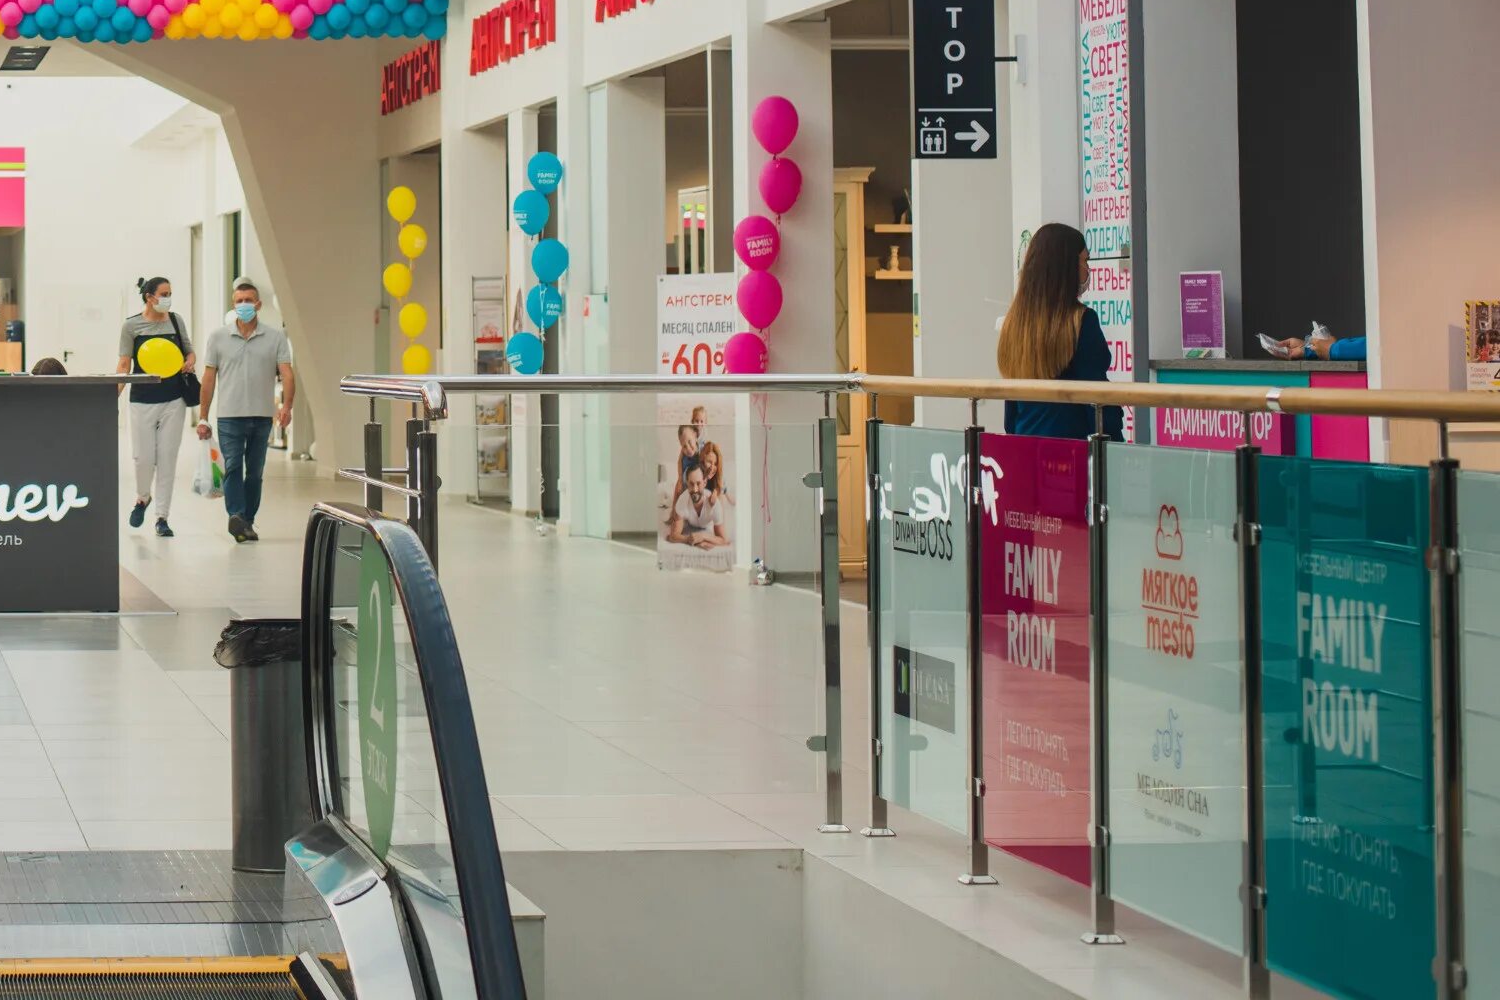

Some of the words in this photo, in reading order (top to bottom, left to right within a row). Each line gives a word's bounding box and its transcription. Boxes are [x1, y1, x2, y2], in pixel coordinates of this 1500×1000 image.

[1106, 21, 1121, 41] УЮТ
[381, 39, 441, 116] АНГСТРЕМ
[1091, 42, 1120, 78] СВЕТ
[1082, 29, 1093, 194] ОТДЕЛКА
[1092, 95, 1107, 112] СВЕТ
[746, 238, 774, 249] FAMILY
[750, 246, 773, 257] ROOM
[1088, 266, 1130, 292] ТЕРЬЕ
[666, 294, 733, 307] АНГСТРЕМ
[1088, 300, 1131, 326] ЕЛКА
[662, 323, 694, 335] МЕСЯЦ
[1164, 407, 1272, 441] АДМИНИСТРАТОР
[895, 521, 916, 544] DIVAN
[919, 518, 953, 561] BOSS
[1005, 511, 1041, 532] МЕБЕЛЬНЫЙ
[1042, 517, 1062, 536] ЦЕНТР
[1005, 541, 1062, 605] FAMILY
[1355, 561, 1387, 587] ЦЕНТР
[1007, 610, 1055, 674] ROOM
[1146, 612, 1195, 659] mesto
[1297, 591, 1387, 674] FAMILY
[1006, 720, 1031, 748] ЛЕГКО
[1303, 677, 1379, 763] ROOM
[1022, 760, 1066, 797] ПОКУПАТЬ
[1137, 772, 1185, 808] МЕЛОДИЯ
[1187, 790, 1209, 817] СНА
[1327, 868, 1396, 920] ПОКУПАТЬ
